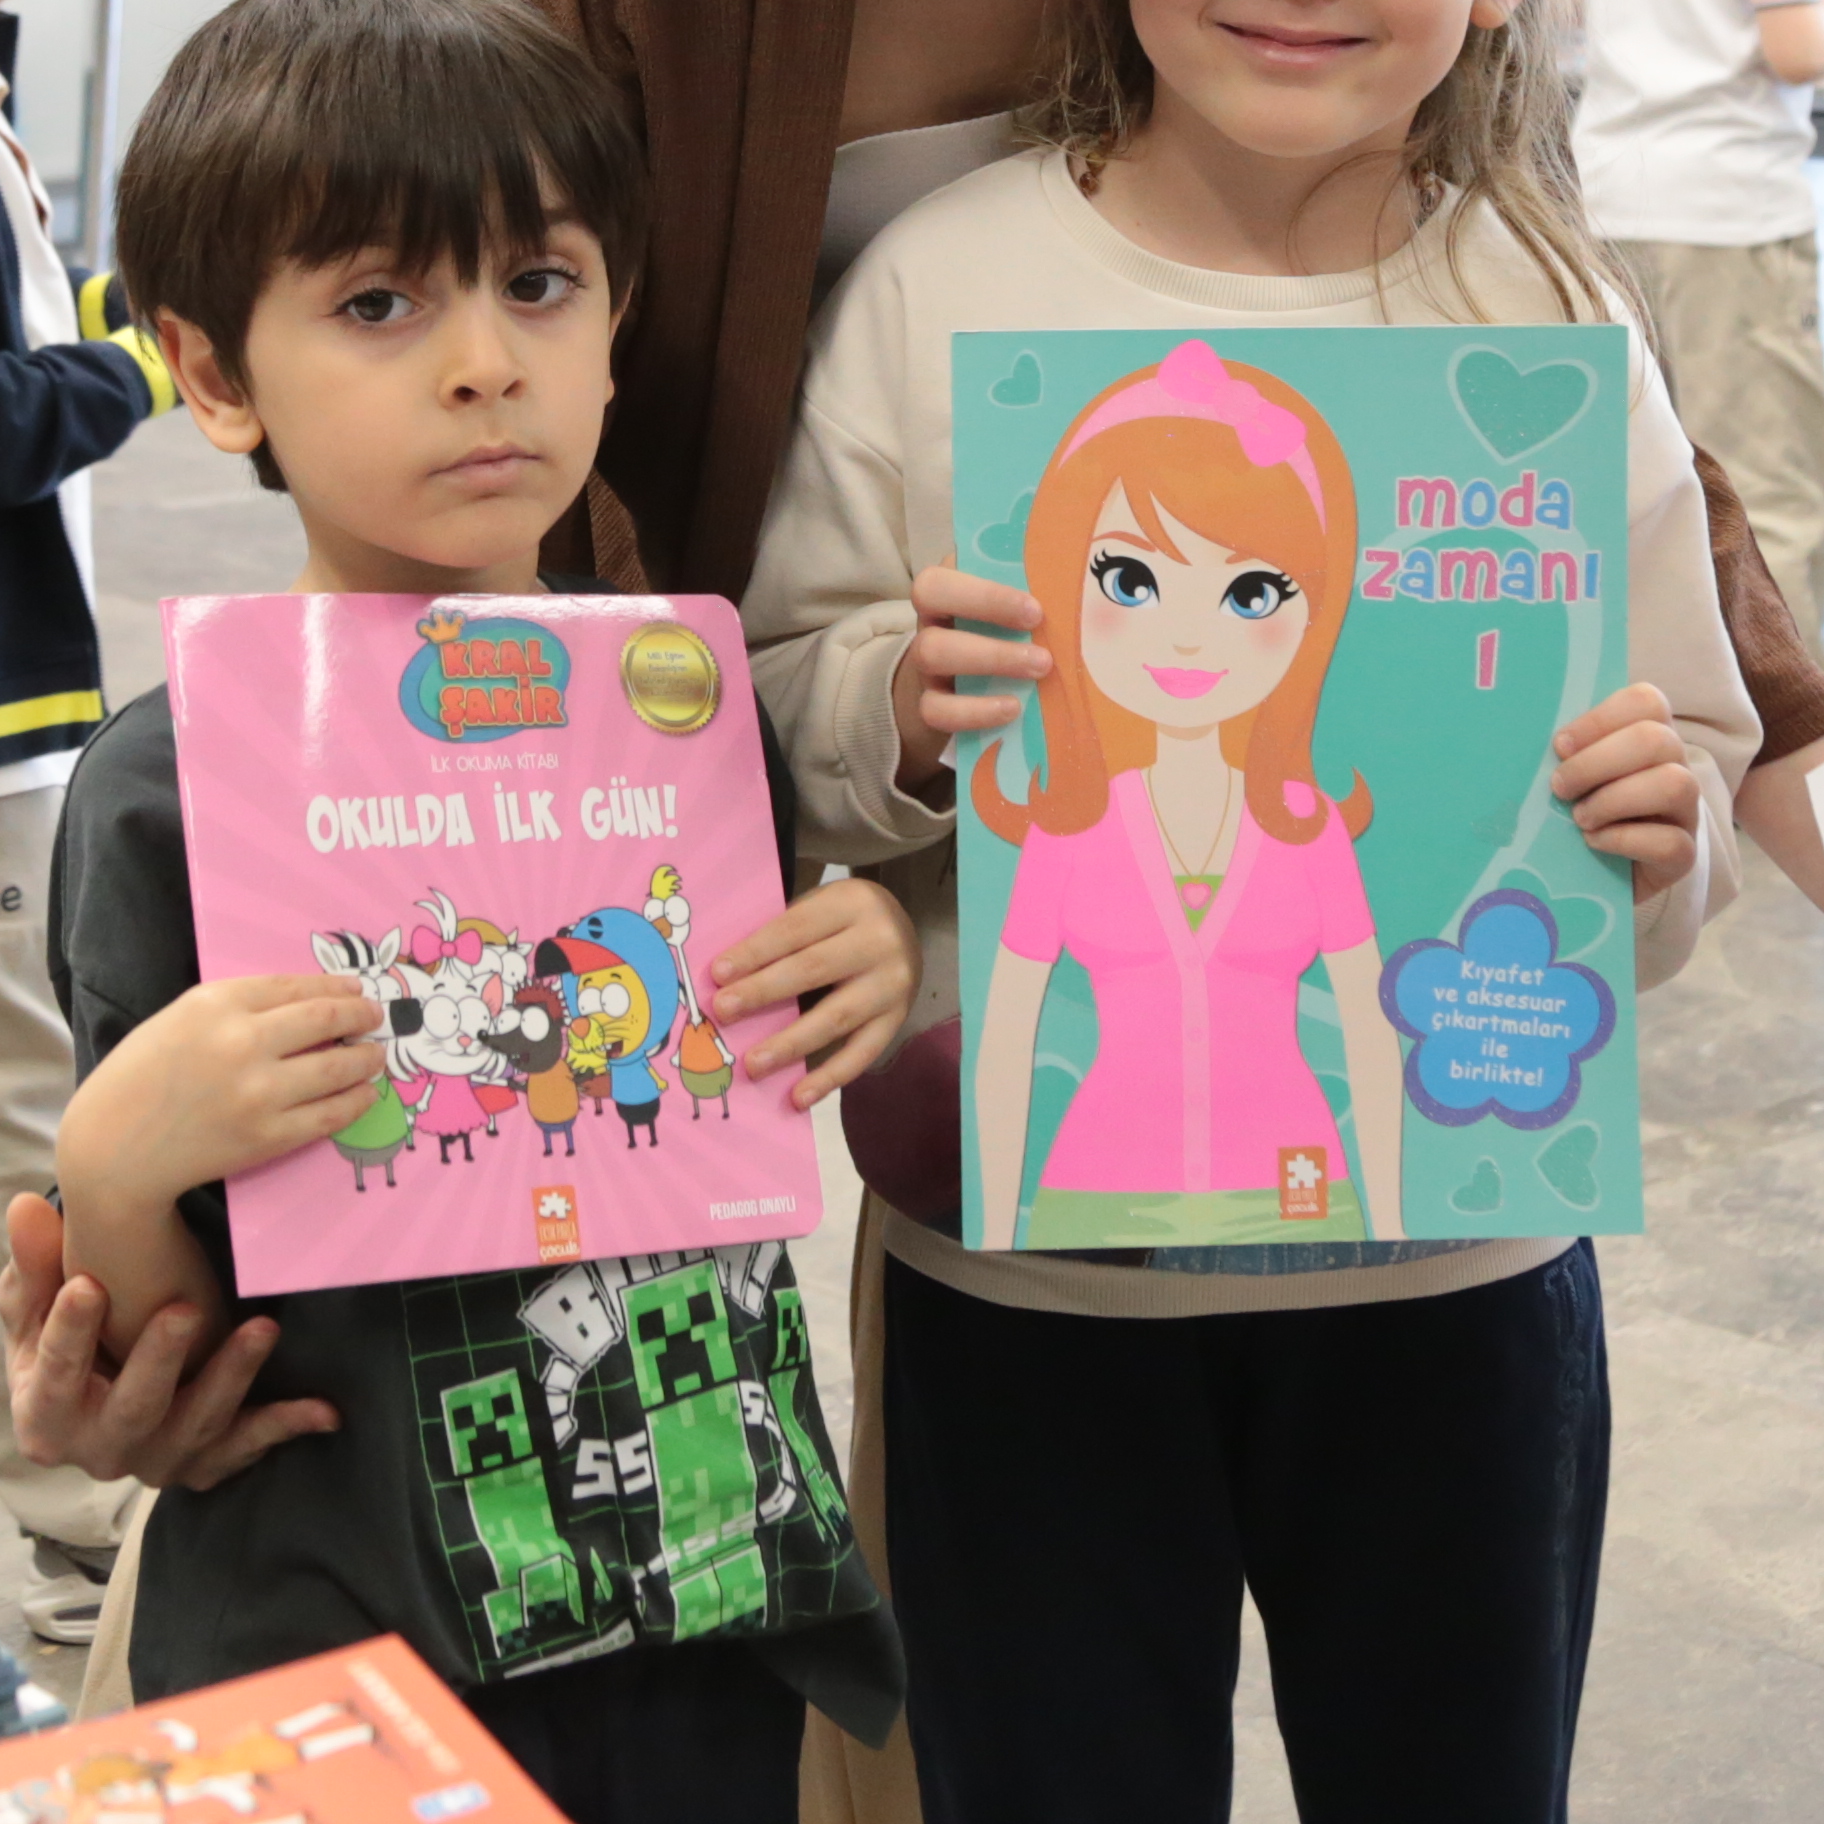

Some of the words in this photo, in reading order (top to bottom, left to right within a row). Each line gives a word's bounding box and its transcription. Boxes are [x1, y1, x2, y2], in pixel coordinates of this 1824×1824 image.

[1396, 471, 1572, 531] moda
[1361, 547, 1601, 603] zamanı
[440, 639, 552, 678] KRAL
[439, 675, 567, 738] ŞAKİR
[430, 753, 451, 773] İLK
[456, 753, 513, 772] OKUMA
[516, 750, 560, 770] KİTABI
[306, 792, 476, 854] OKULDA
[492, 781, 563, 844] İLK
[580, 775, 679, 842] GÜN!
[1460, 959, 1545, 986] Kıyafet
[1433, 987, 1459, 1002] ve
[1466, 986, 1567, 1014] aksesuar
[1432, 1008, 1571, 1039] çıkartmaları
[1481, 1037, 1509, 1058] ile
[1449, 1059, 1545, 1087] birlikte!
[709, 1199, 759, 1221] PEDAGOG
[759, 1195, 797, 1216] ONAYLI
